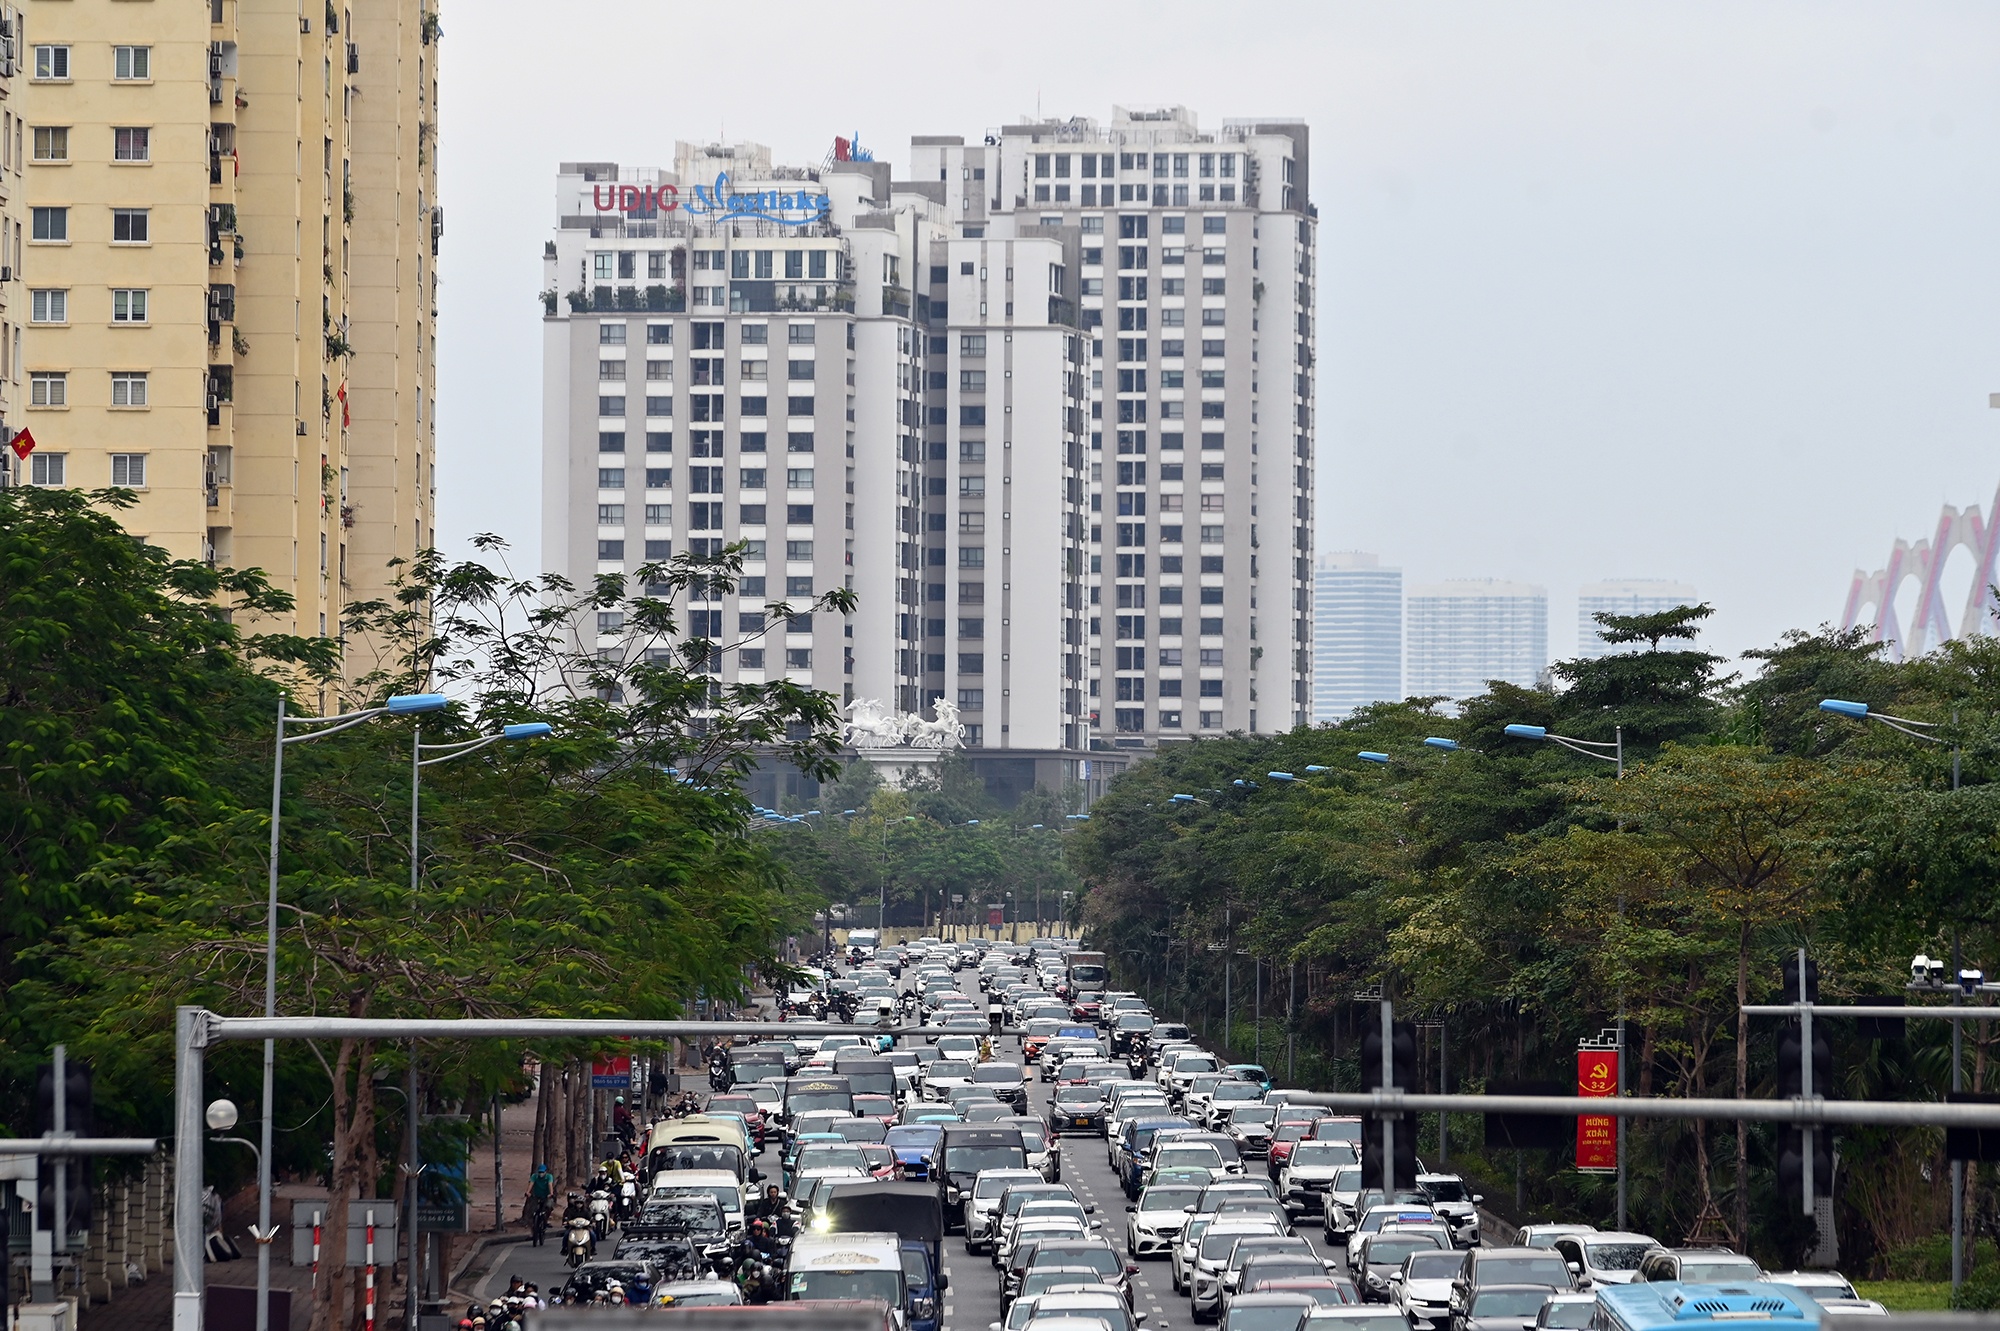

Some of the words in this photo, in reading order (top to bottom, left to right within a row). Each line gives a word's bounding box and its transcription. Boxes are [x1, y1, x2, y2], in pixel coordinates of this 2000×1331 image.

[594, 184, 679, 212] UDIC
[682, 171, 831, 224] Westlake
[1586, 1128, 1609, 1138] XUÂN
